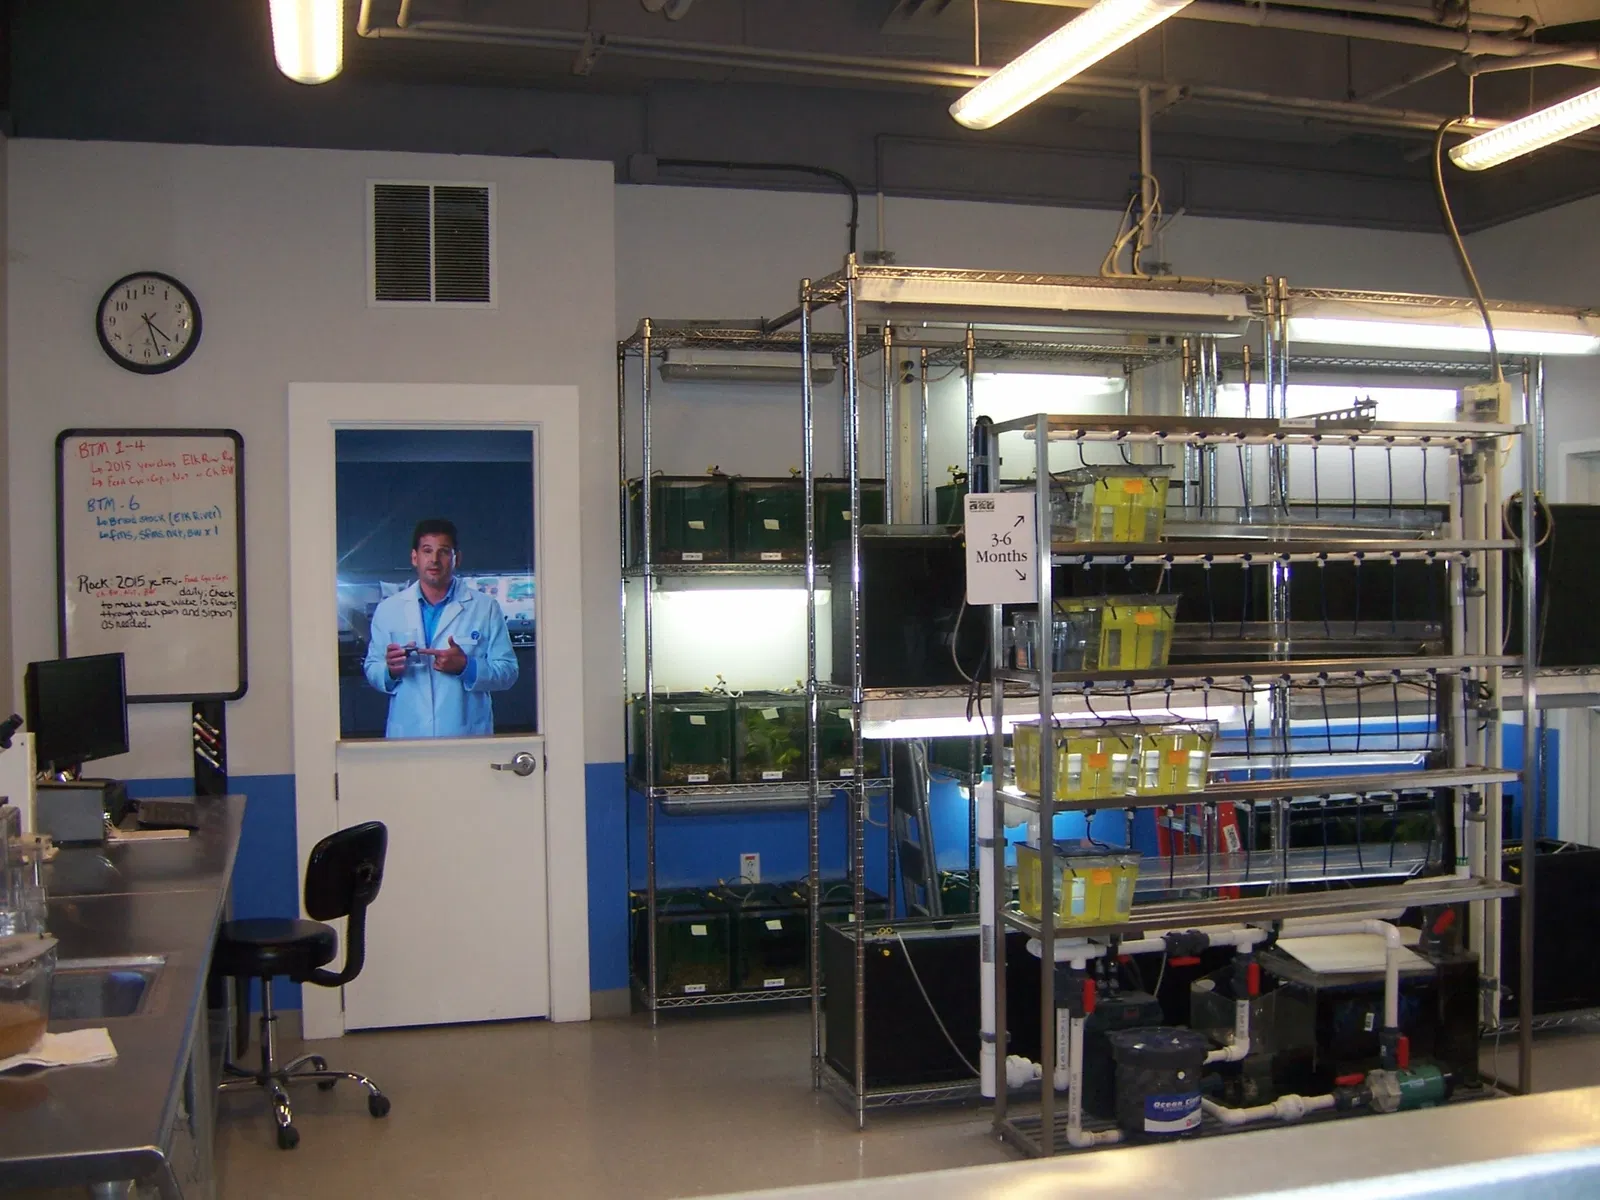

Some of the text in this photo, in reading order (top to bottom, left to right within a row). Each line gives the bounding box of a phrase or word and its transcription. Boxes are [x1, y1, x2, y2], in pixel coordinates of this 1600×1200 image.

[126, 289, 138, 300] 11
[142, 285, 155, 295] 12
[116, 301, 128, 312] 10
[109, 316, 116, 326] 9
[79, 441, 109, 459] BTM
[105, 460, 132, 472] 2015
[87, 497, 115, 512] BTM
[129, 495, 140, 511] 6
[991, 531, 1012, 548] 3-6
[976, 549, 1028, 564] Months
[115, 575, 146, 589] 2015
[182, 608, 200, 617] and
[1153, 1101, 1183, 1110] Ocean
